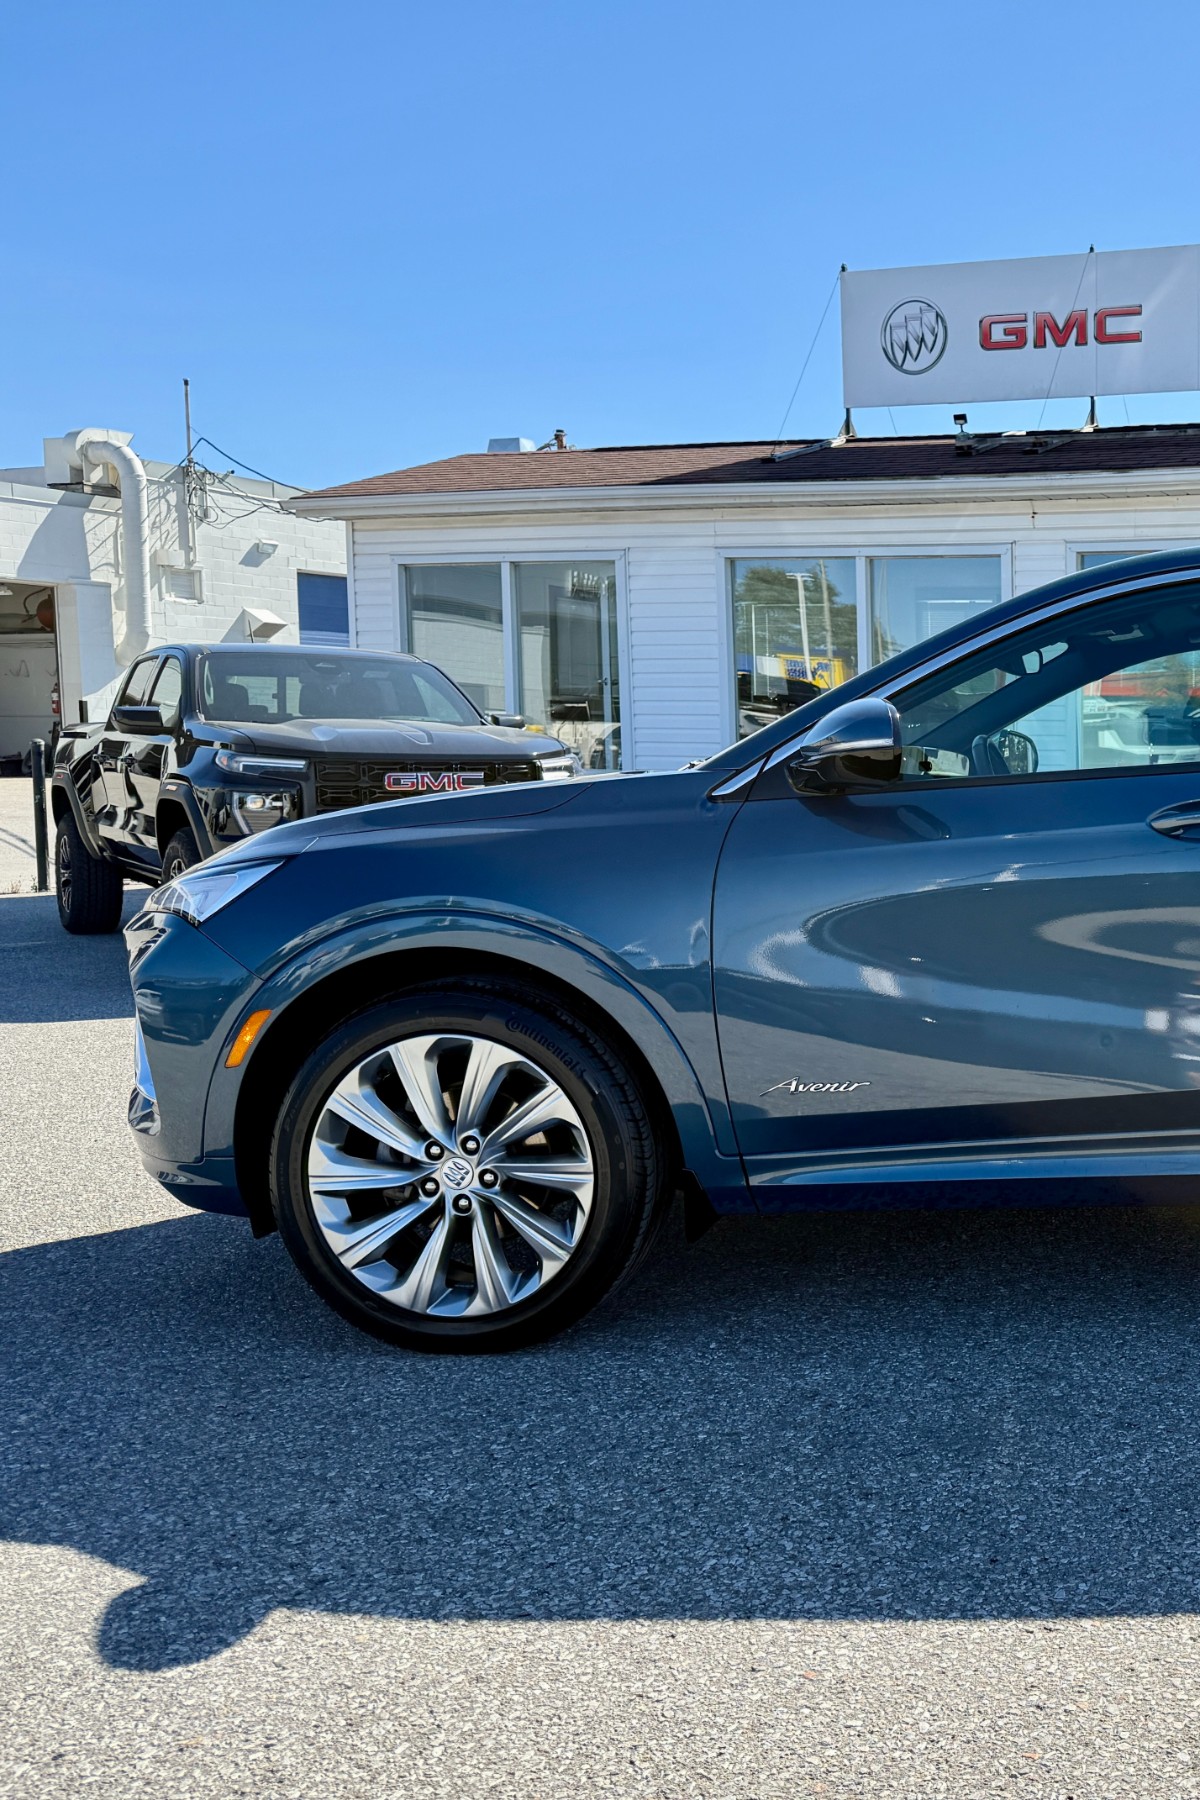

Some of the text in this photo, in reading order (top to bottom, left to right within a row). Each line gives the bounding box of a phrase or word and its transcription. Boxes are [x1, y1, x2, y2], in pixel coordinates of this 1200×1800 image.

[979, 305, 1142, 352] GMC
[384, 771, 485, 791] GMC
[505, 1017, 580, 1071] Continental
[759, 1076, 870, 1096] Avenir
